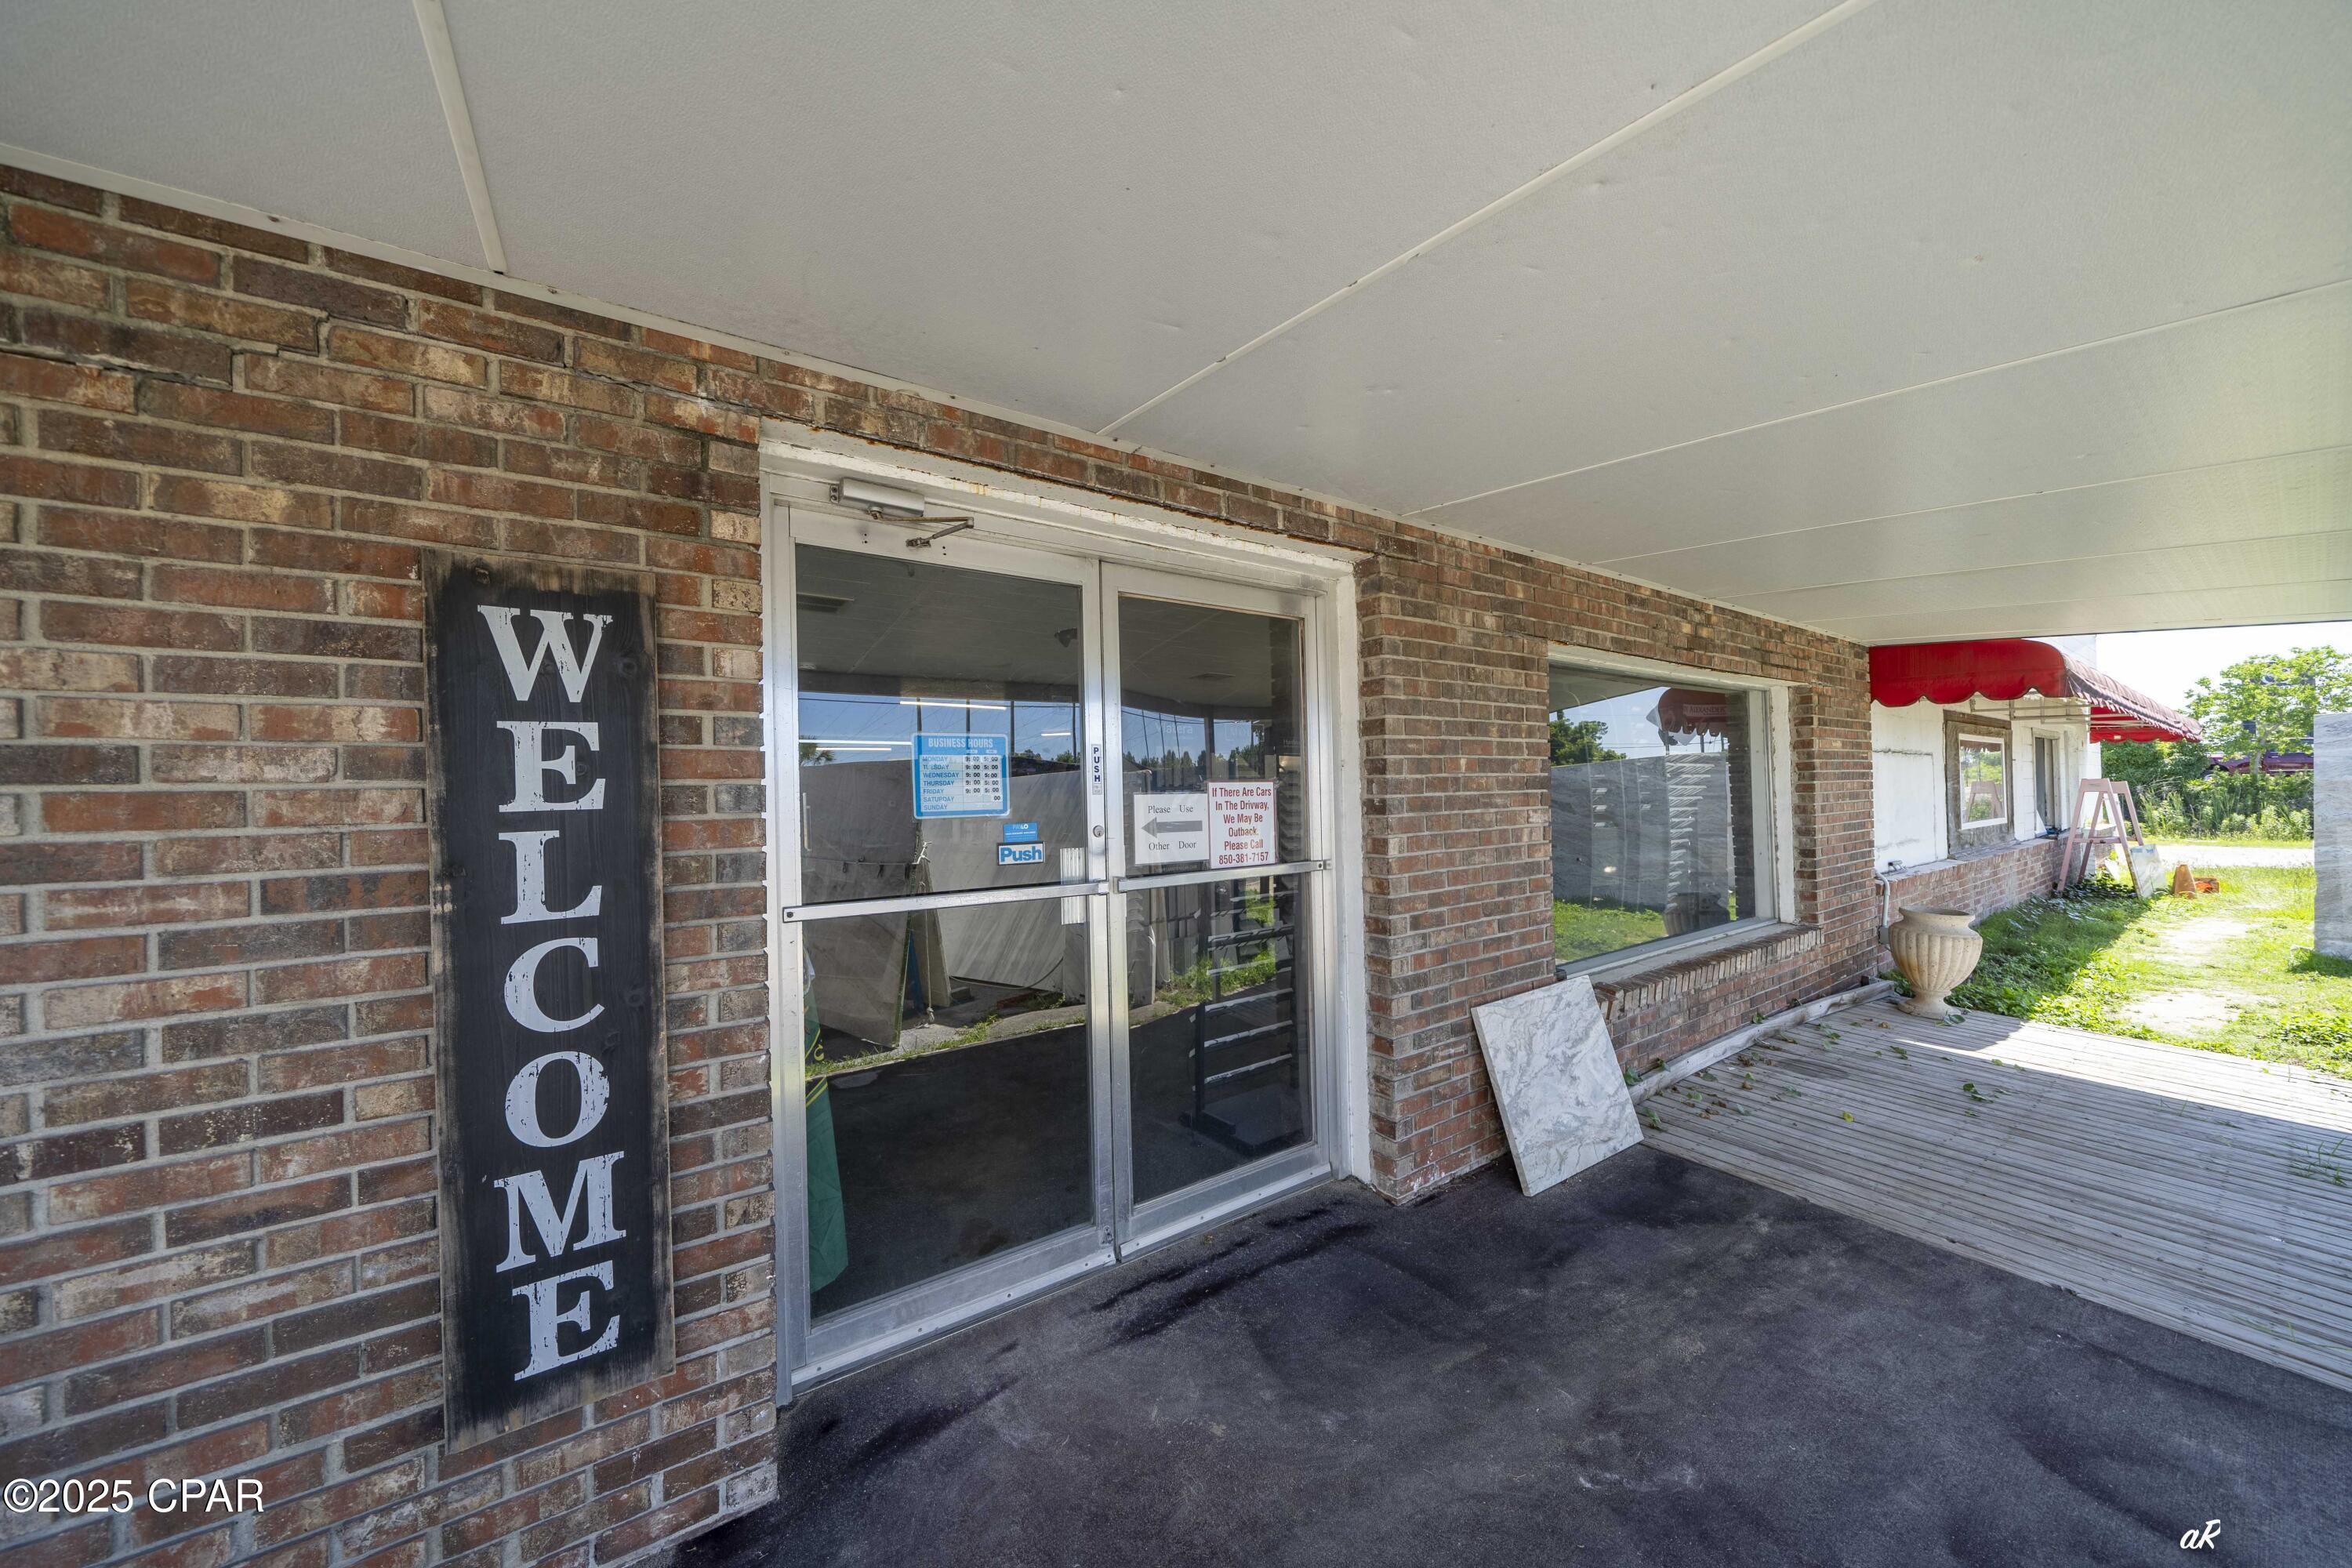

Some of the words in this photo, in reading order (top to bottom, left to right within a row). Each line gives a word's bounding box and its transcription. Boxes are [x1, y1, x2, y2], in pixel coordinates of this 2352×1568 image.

[928, 738, 965, 748] BUSINESS
[967, 738, 993, 748] HOURS
[1212, 787, 1218, 797] If
[1219, 787, 1240, 797] There
[1242, 786, 1254, 797] Are
[1256, 786, 1272, 797] Cars
[1148, 805, 1171, 814] Please
[1179, 804, 1193, 813] Use
[1215, 801, 1222, 811] In
[1225, 800, 1238, 811] The
[1223, 814, 1235, 824] We
[1237, 814, 1252, 825] May
[1254, 813, 1263, 822] Be
[1178, 840, 1197, 849] Door
[1224, 840, 1248, 851] Please
[1250, 839, 1263, 849] Call
[1000, 846, 1042, 862] Push
[1218, 851, 1269, 865] 850-381-7157
[477, 604, 626, 1381] WELCOME
